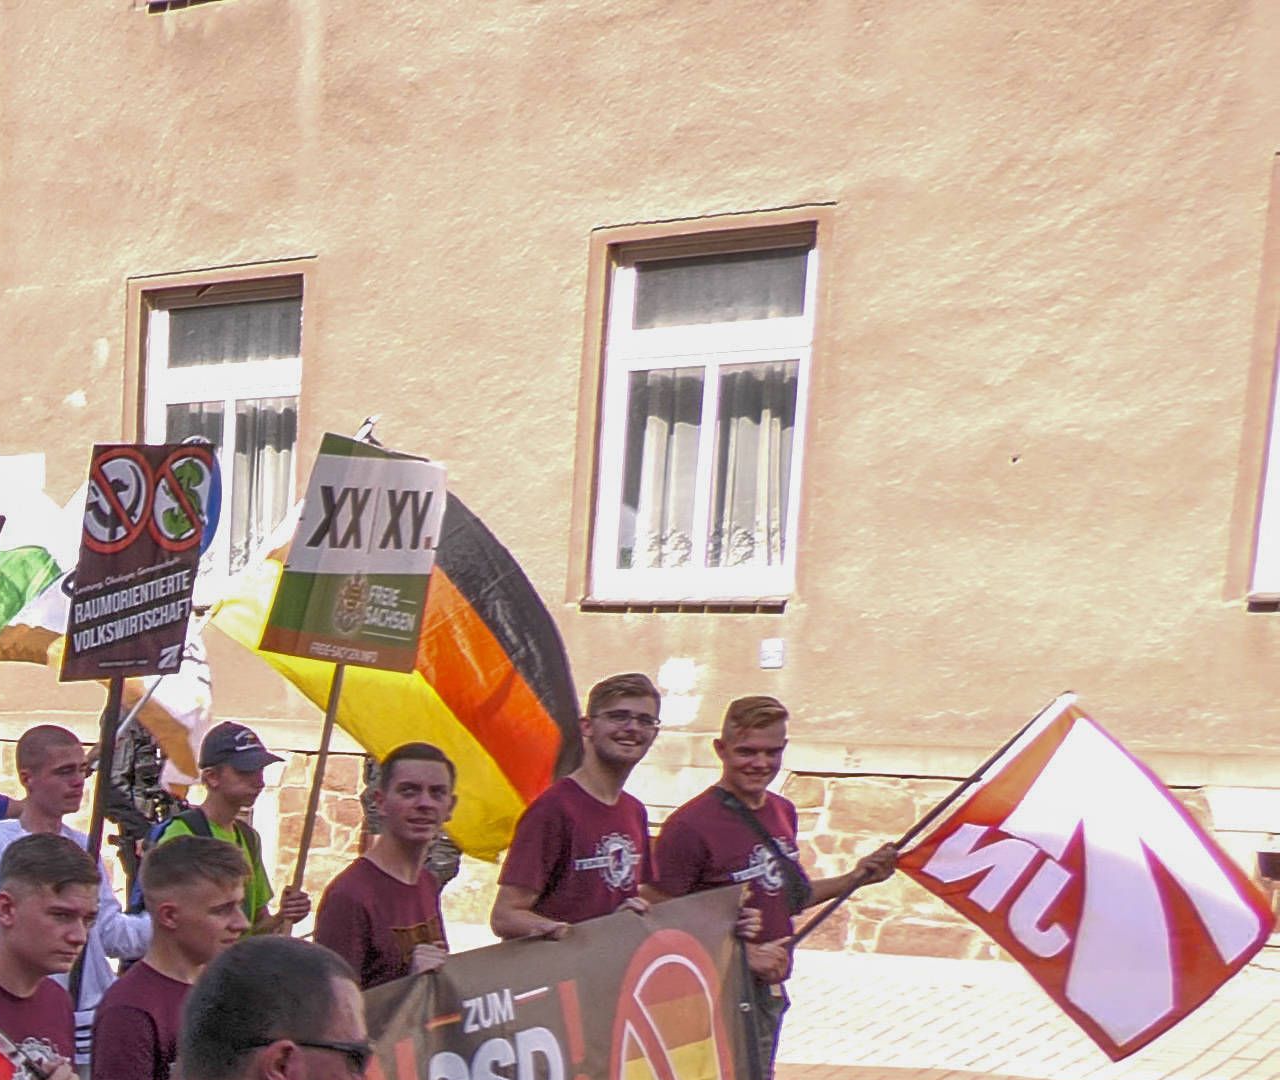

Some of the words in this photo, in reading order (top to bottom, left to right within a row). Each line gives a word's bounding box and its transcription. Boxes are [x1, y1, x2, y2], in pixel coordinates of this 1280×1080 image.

[306, 485, 371, 549] XX
[72, 596, 192, 653] VOLKSWIRTSCHAFT
[74, 569, 192, 624] RAUMORIENTIERTE
[462, 988, 515, 1034] ZUM
